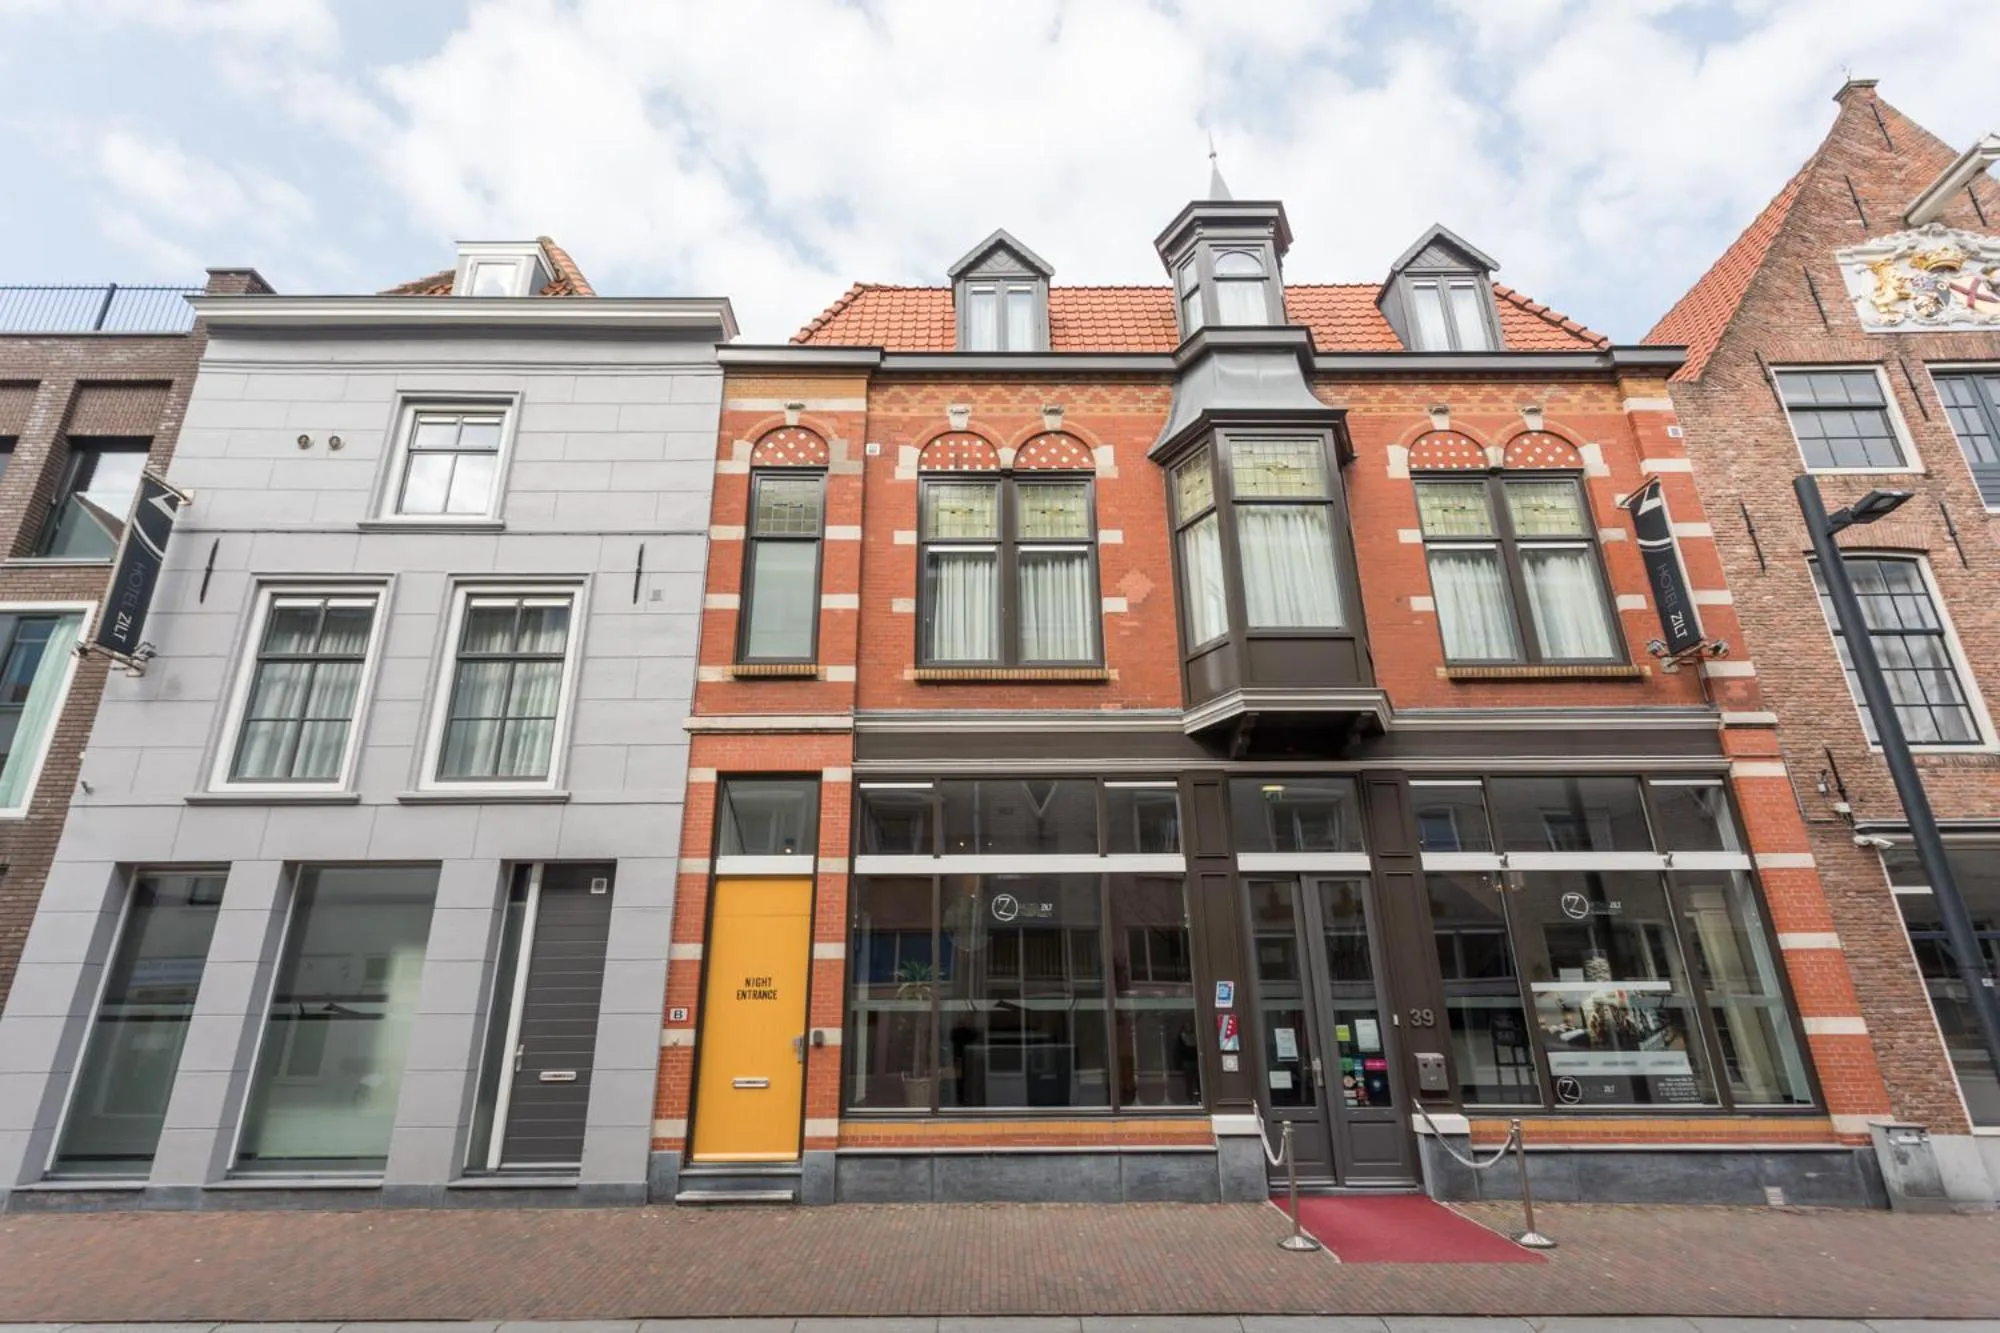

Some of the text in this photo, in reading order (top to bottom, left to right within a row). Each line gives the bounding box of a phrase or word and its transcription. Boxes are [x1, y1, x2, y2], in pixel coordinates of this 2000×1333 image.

[113, 561, 147, 643] HOTEL ZILT
[1656, 563, 1689, 639] HOTEL ZILT
[744, 976, 773, 987] NIGHT
[736, 989, 778, 1001] ENTRANCE
[1409, 1008, 1434, 1027] 39
